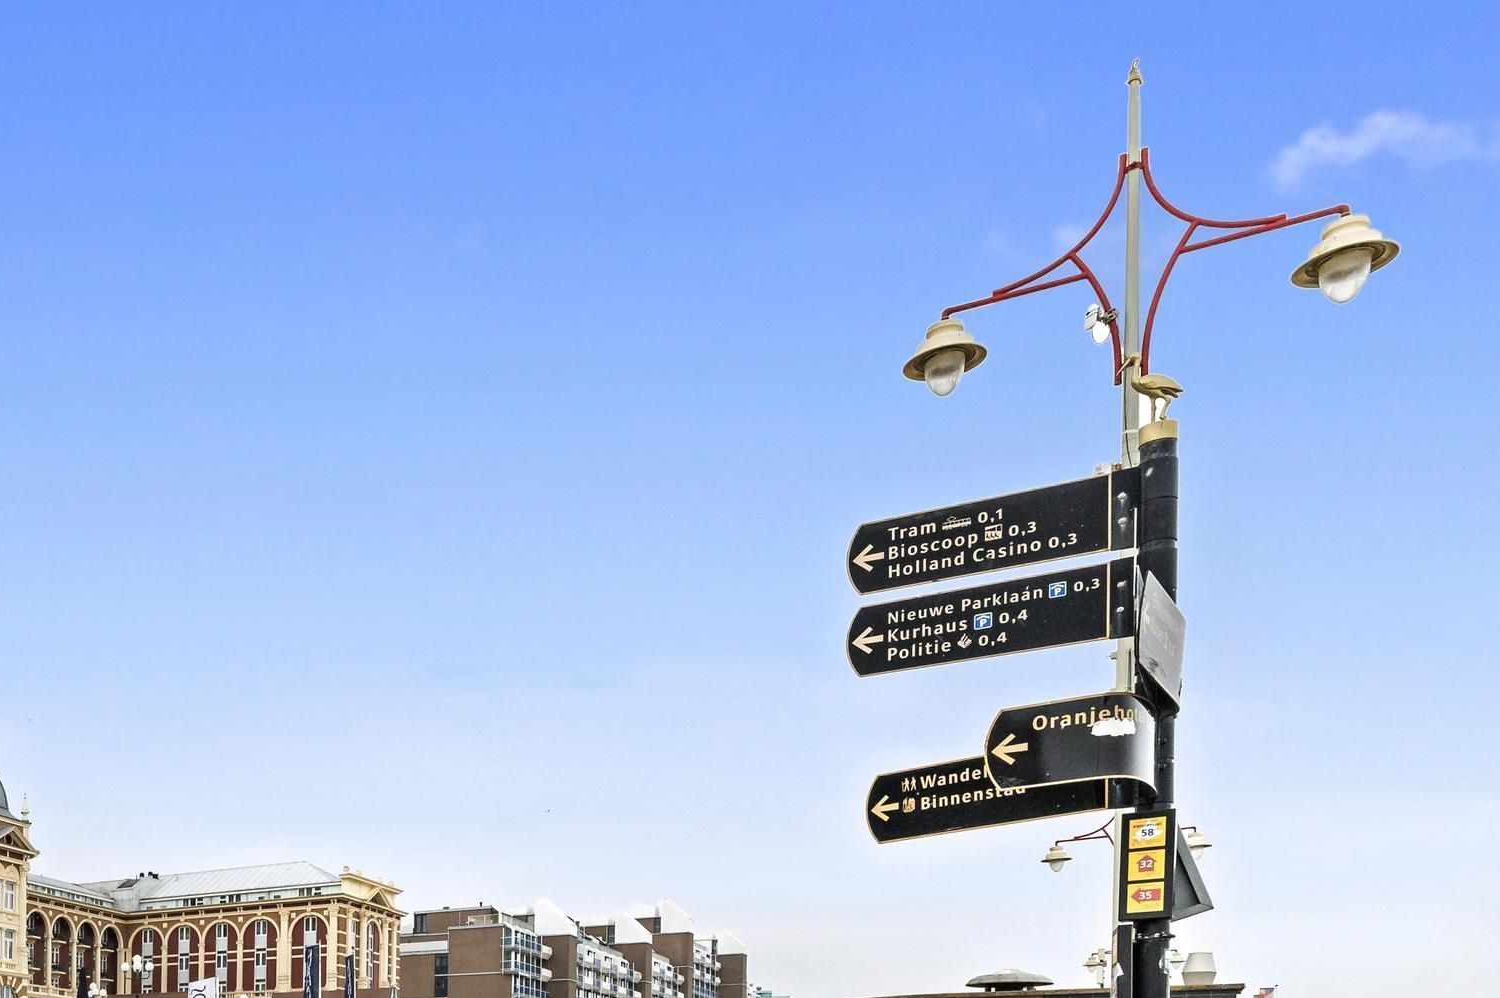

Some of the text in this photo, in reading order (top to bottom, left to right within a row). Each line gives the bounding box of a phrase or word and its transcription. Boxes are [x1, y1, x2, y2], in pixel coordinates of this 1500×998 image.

[888, 508, 1003, 541] Tram 0,1
[888, 521, 1037, 561] Bioscoop 0,3
[888, 533, 1078, 579] Holland Casino 0,3
[887, 603, 954, 624] Nieuwe
[1073, 578, 1100, 593] 0,3
[887, 618, 968, 643] Kurhaus
[999, 609, 1029, 625] 0,4
[887, 631, 1008, 661] Politie 0,4
[1141, 828, 1155, 837] 58
[1140, 860, 1153, 868] 32
[1139, 891, 1152, 900] 35
